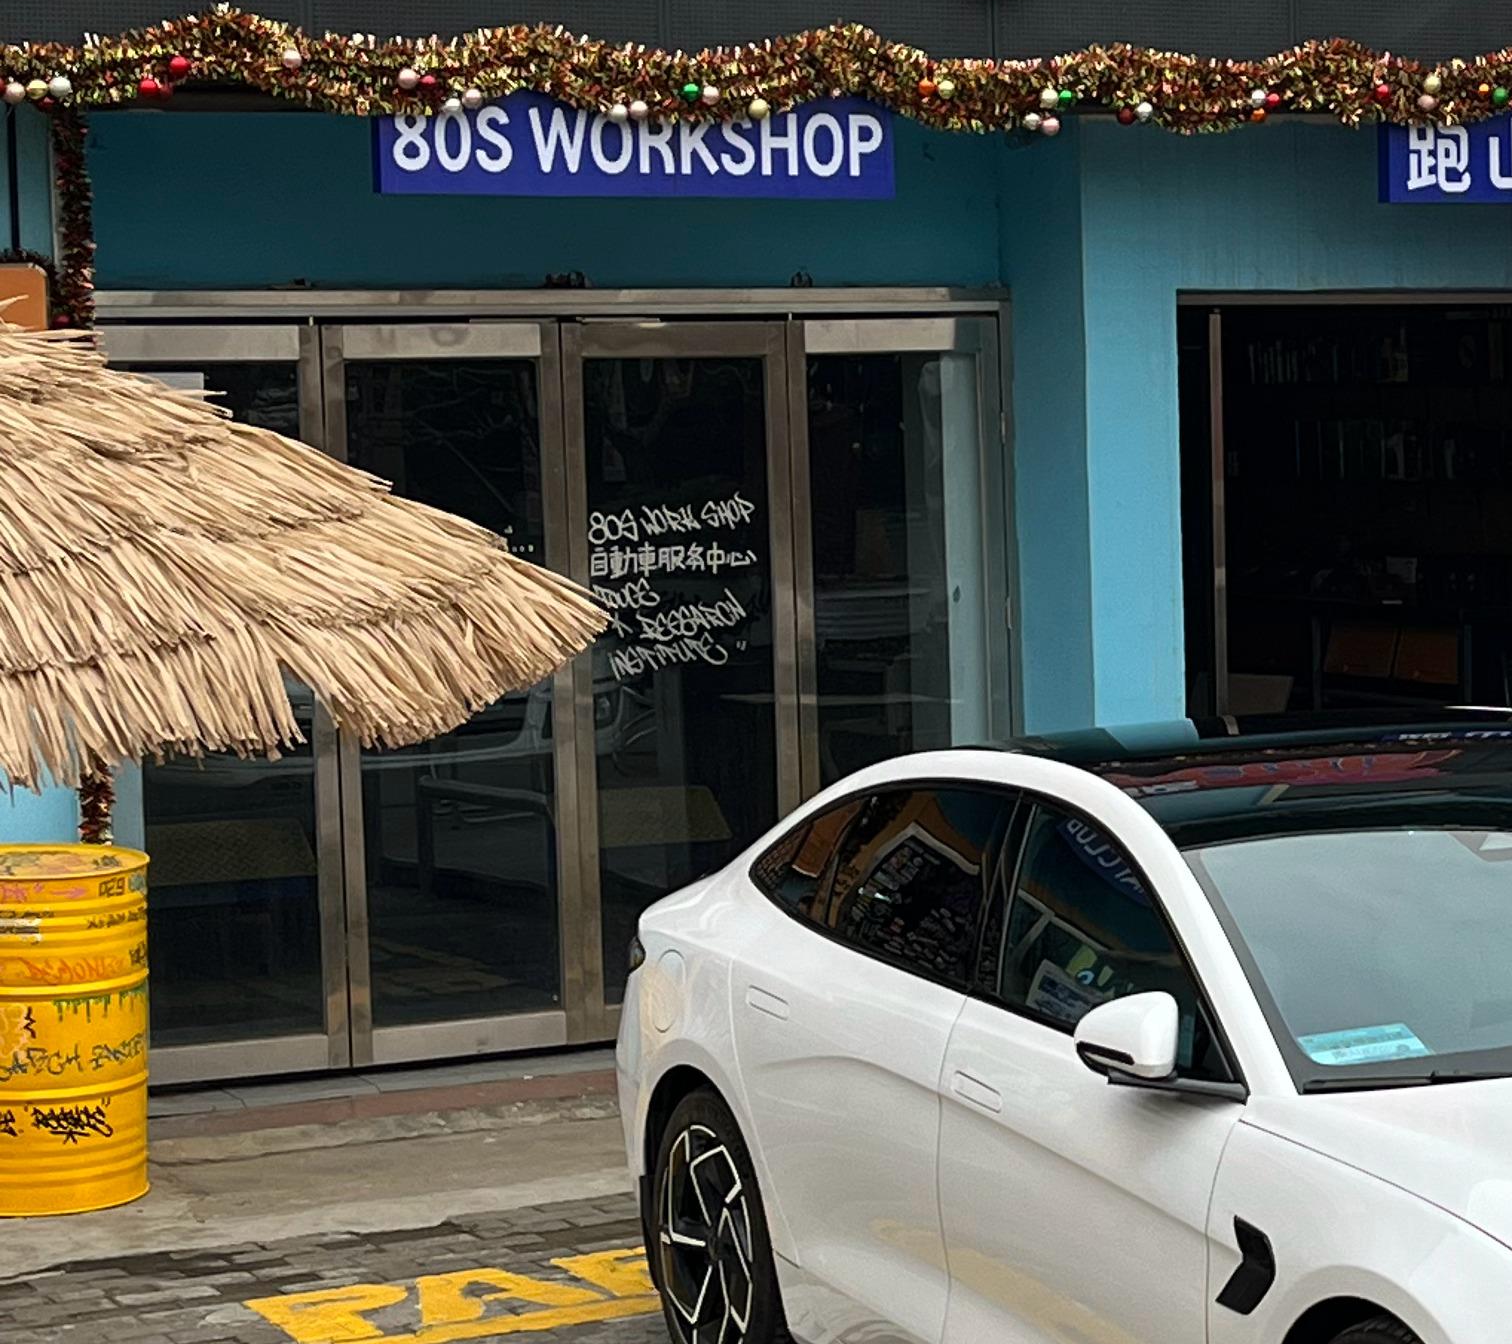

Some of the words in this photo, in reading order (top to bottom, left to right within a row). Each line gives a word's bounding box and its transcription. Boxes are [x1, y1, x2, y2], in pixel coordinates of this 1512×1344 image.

[390, 105, 513, 175] 80S
[527, 106, 885, 179] WORKSHOP
[587, 508, 640, 545] 80S
